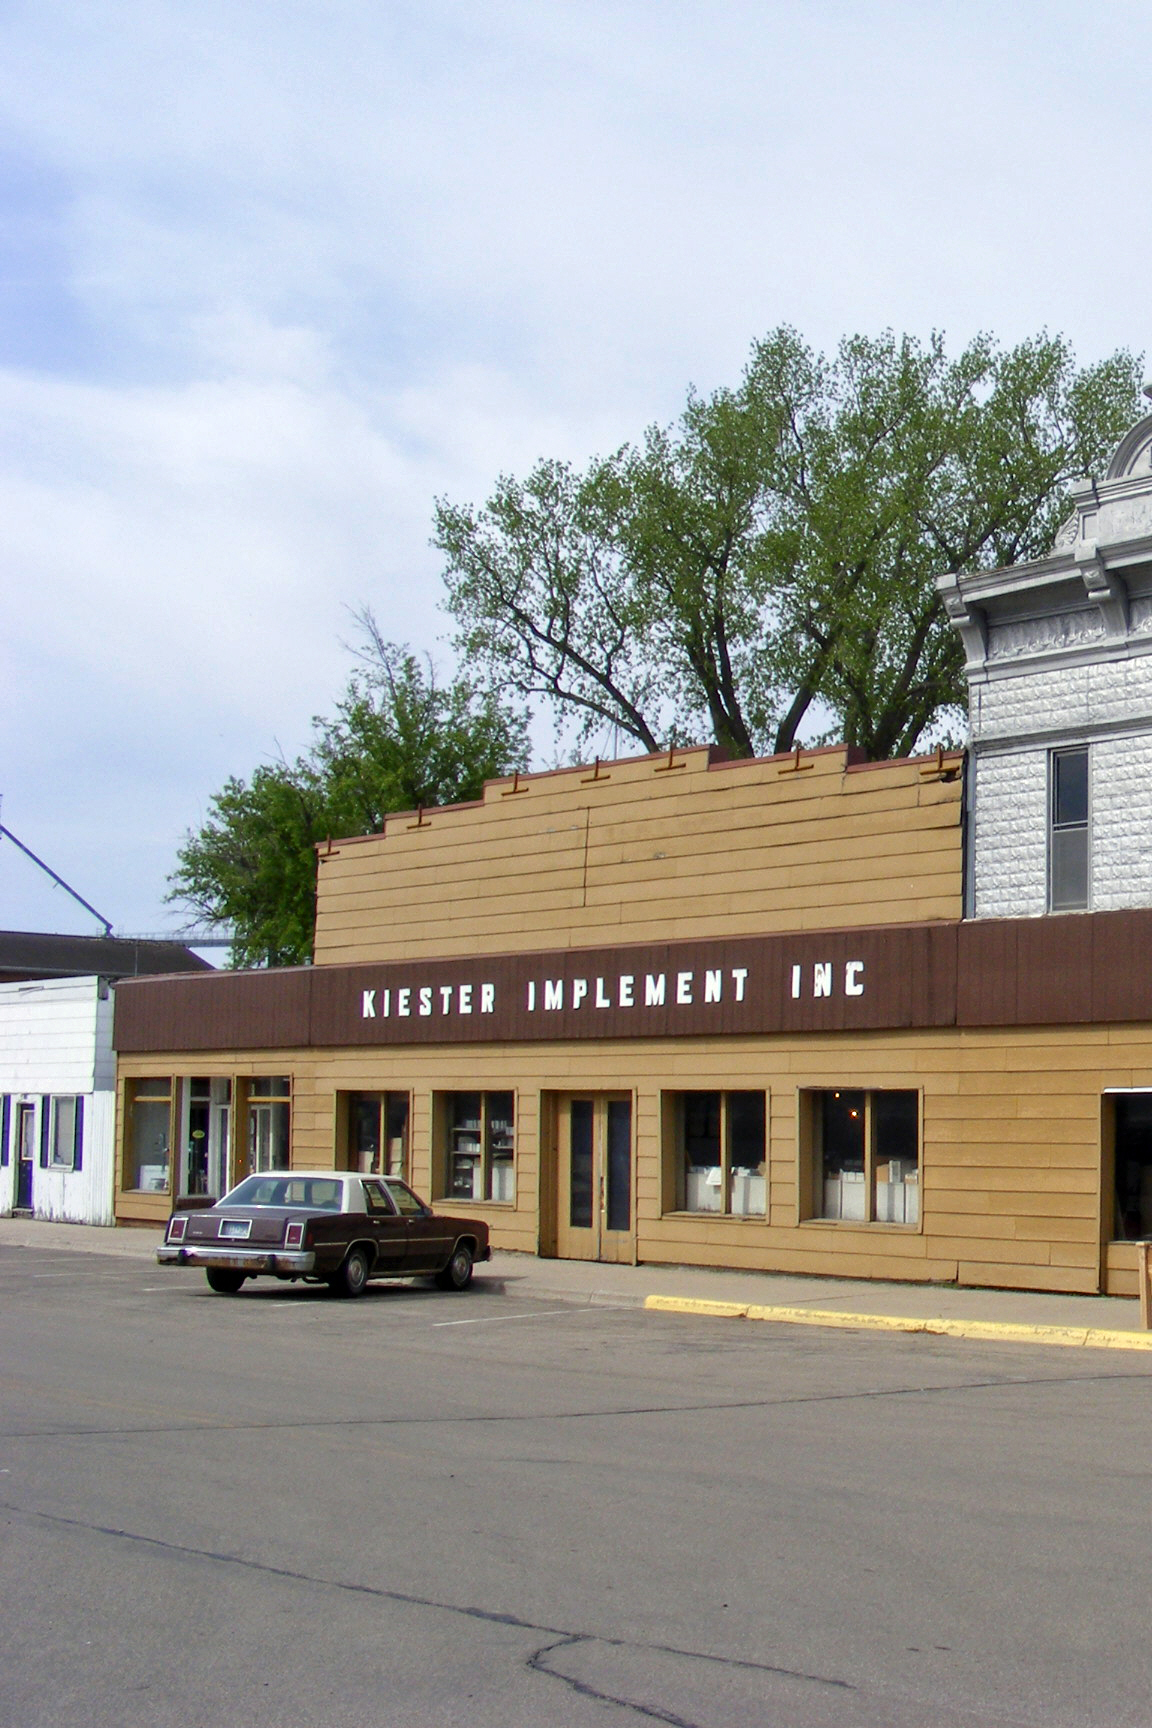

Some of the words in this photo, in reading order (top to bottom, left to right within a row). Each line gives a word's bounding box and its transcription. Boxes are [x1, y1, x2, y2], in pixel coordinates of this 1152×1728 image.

[362, 983, 496, 1018] KIESTER
[527, 968, 749, 1012] IMPLEMENT
[791, 960, 866, 999] INC
